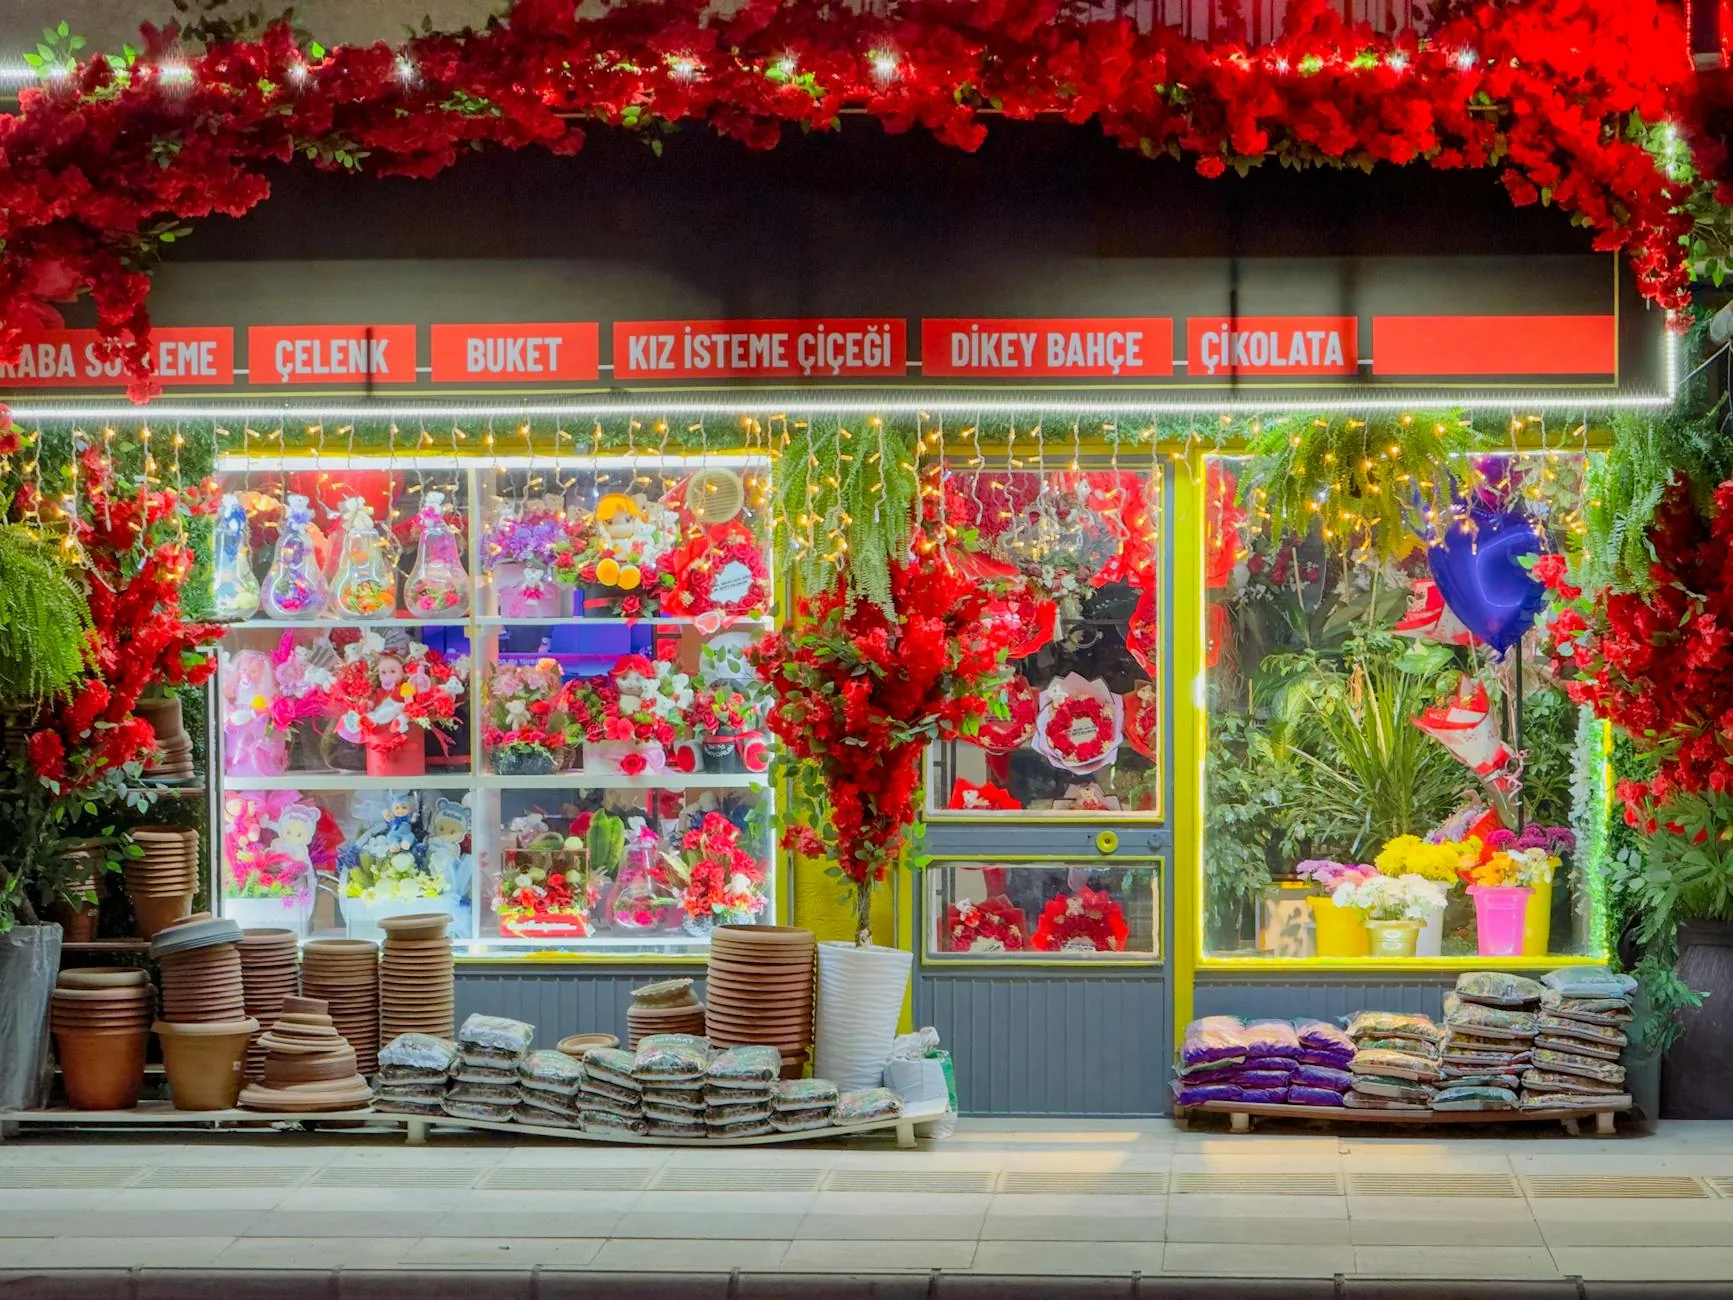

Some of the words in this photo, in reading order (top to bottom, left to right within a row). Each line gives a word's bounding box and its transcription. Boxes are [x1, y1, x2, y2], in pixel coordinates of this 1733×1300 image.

[275, 338, 389, 381] ÇELENK
[466, 336, 563, 373] BUKET
[628, 335, 675, 370] KIZ
[684, 326, 788, 369] İSTEME
[798, 324, 890, 375] ÇİÇEĞİ
[951, 324, 1038, 367] DİKEY
[1047, 331, 1144, 374] BAHÇE
[1200, 323, 1344, 374] ÇİKOLATA
